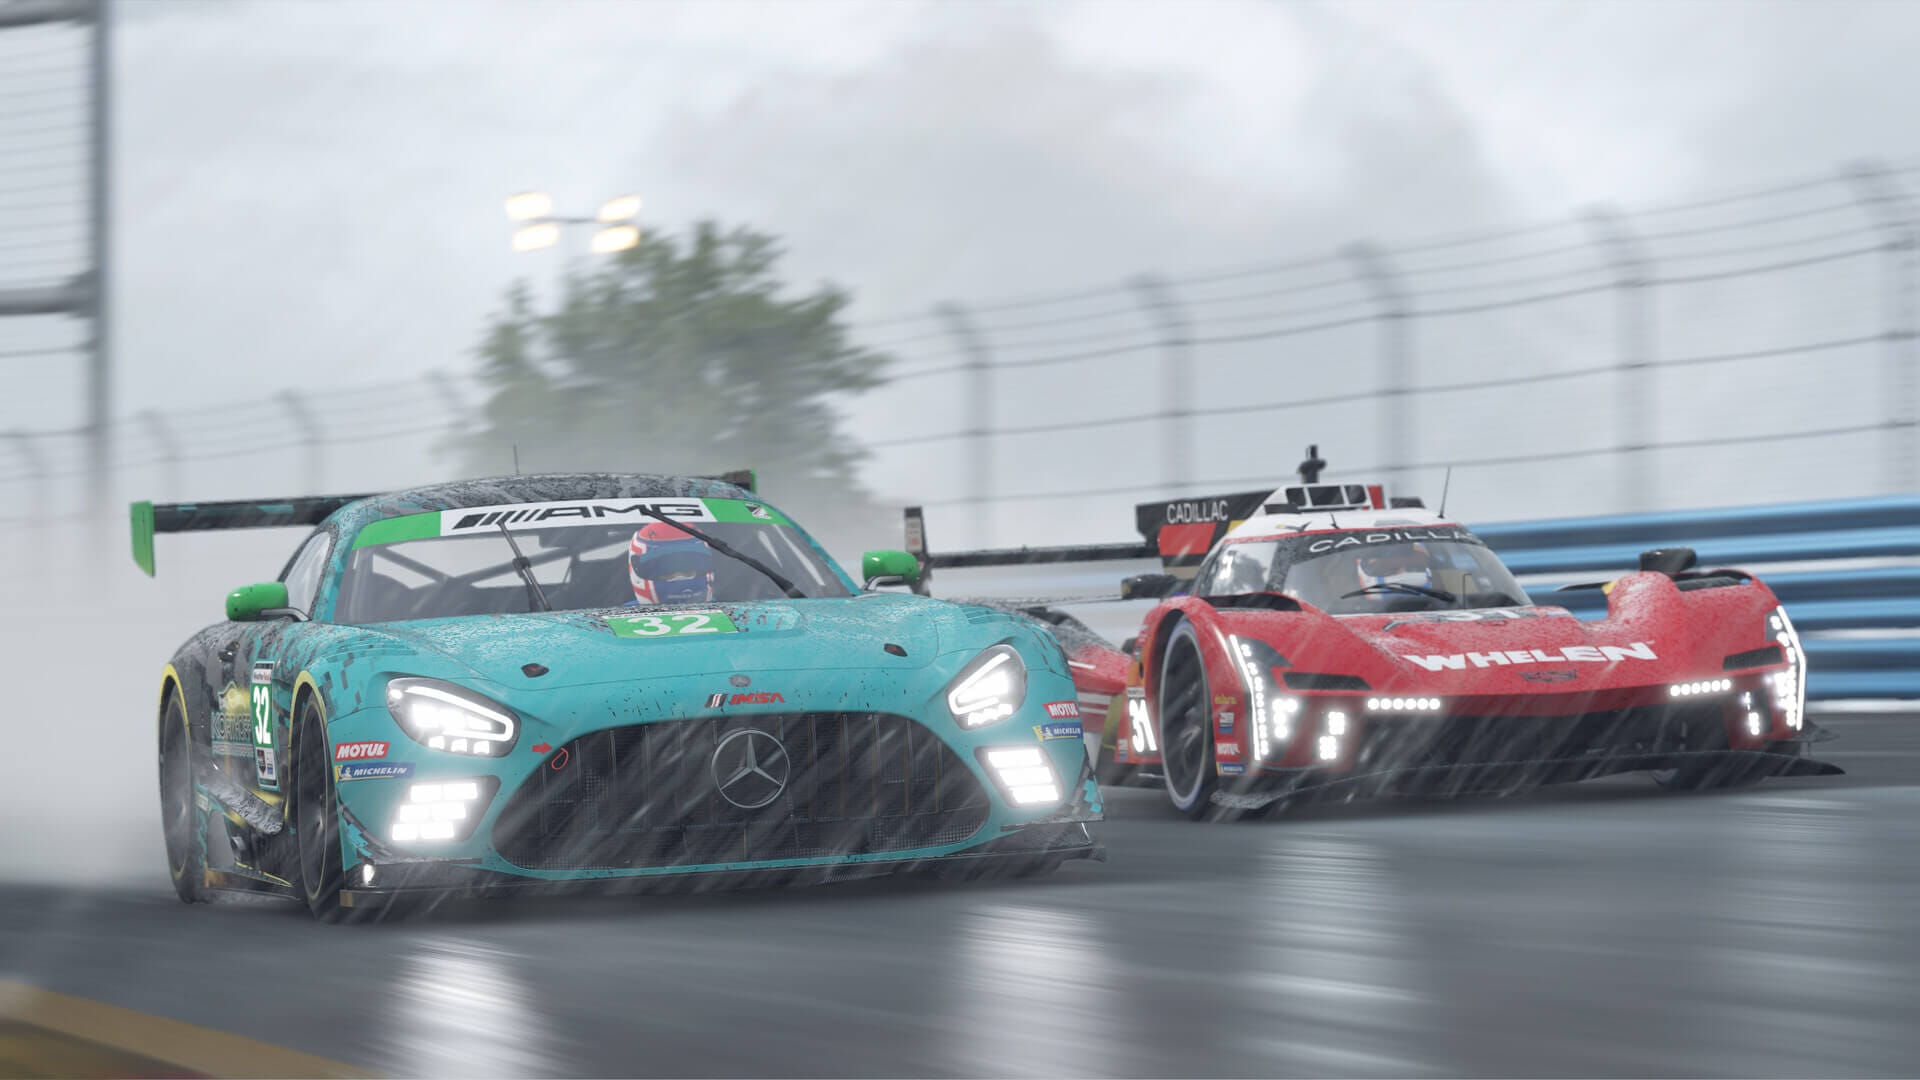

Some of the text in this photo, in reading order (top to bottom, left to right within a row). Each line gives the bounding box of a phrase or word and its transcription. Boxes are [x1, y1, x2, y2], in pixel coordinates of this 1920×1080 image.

[535, 503, 704, 521] AMG
[1166, 500, 1228, 524] CADILLAC
[627, 614, 718, 636] 32
[1403, 642, 1658, 672] WHELEN
[729, 692, 785, 705] IMSA
[253, 686, 272, 744] 32
[1047, 703, 1079, 716] MOTUL
[1053, 727, 1081, 735] MICHELIN
[1129, 698, 1157, 753] 31
[336, 743, 385, 759] MOTUL
[353, 767, 408, 776] MICHELIN
